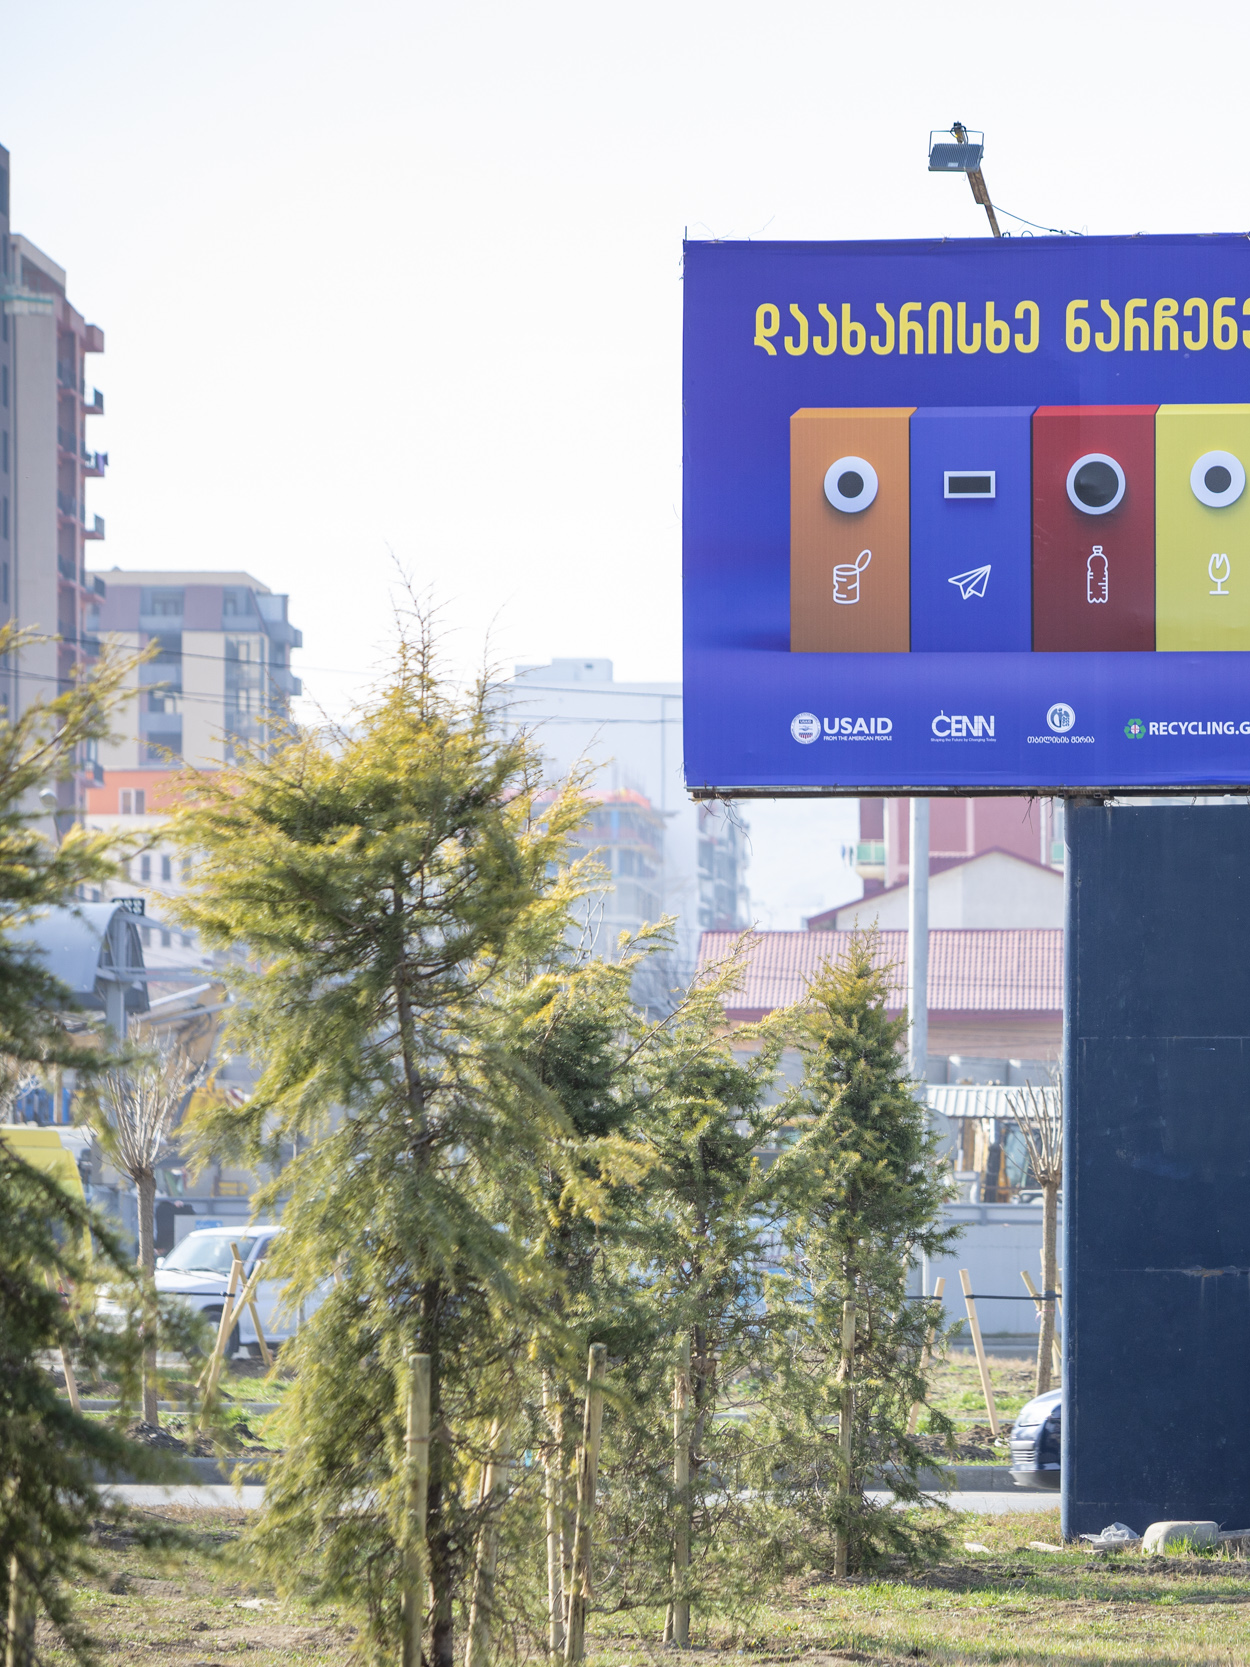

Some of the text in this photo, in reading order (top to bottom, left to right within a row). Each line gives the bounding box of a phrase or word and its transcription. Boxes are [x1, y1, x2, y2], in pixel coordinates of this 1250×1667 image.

[754, 301, 1039, 356] დაახარისხე
[823, 717, 893, 735] USAID
[1027, 735, 1095, 744] თბილისის მერია
